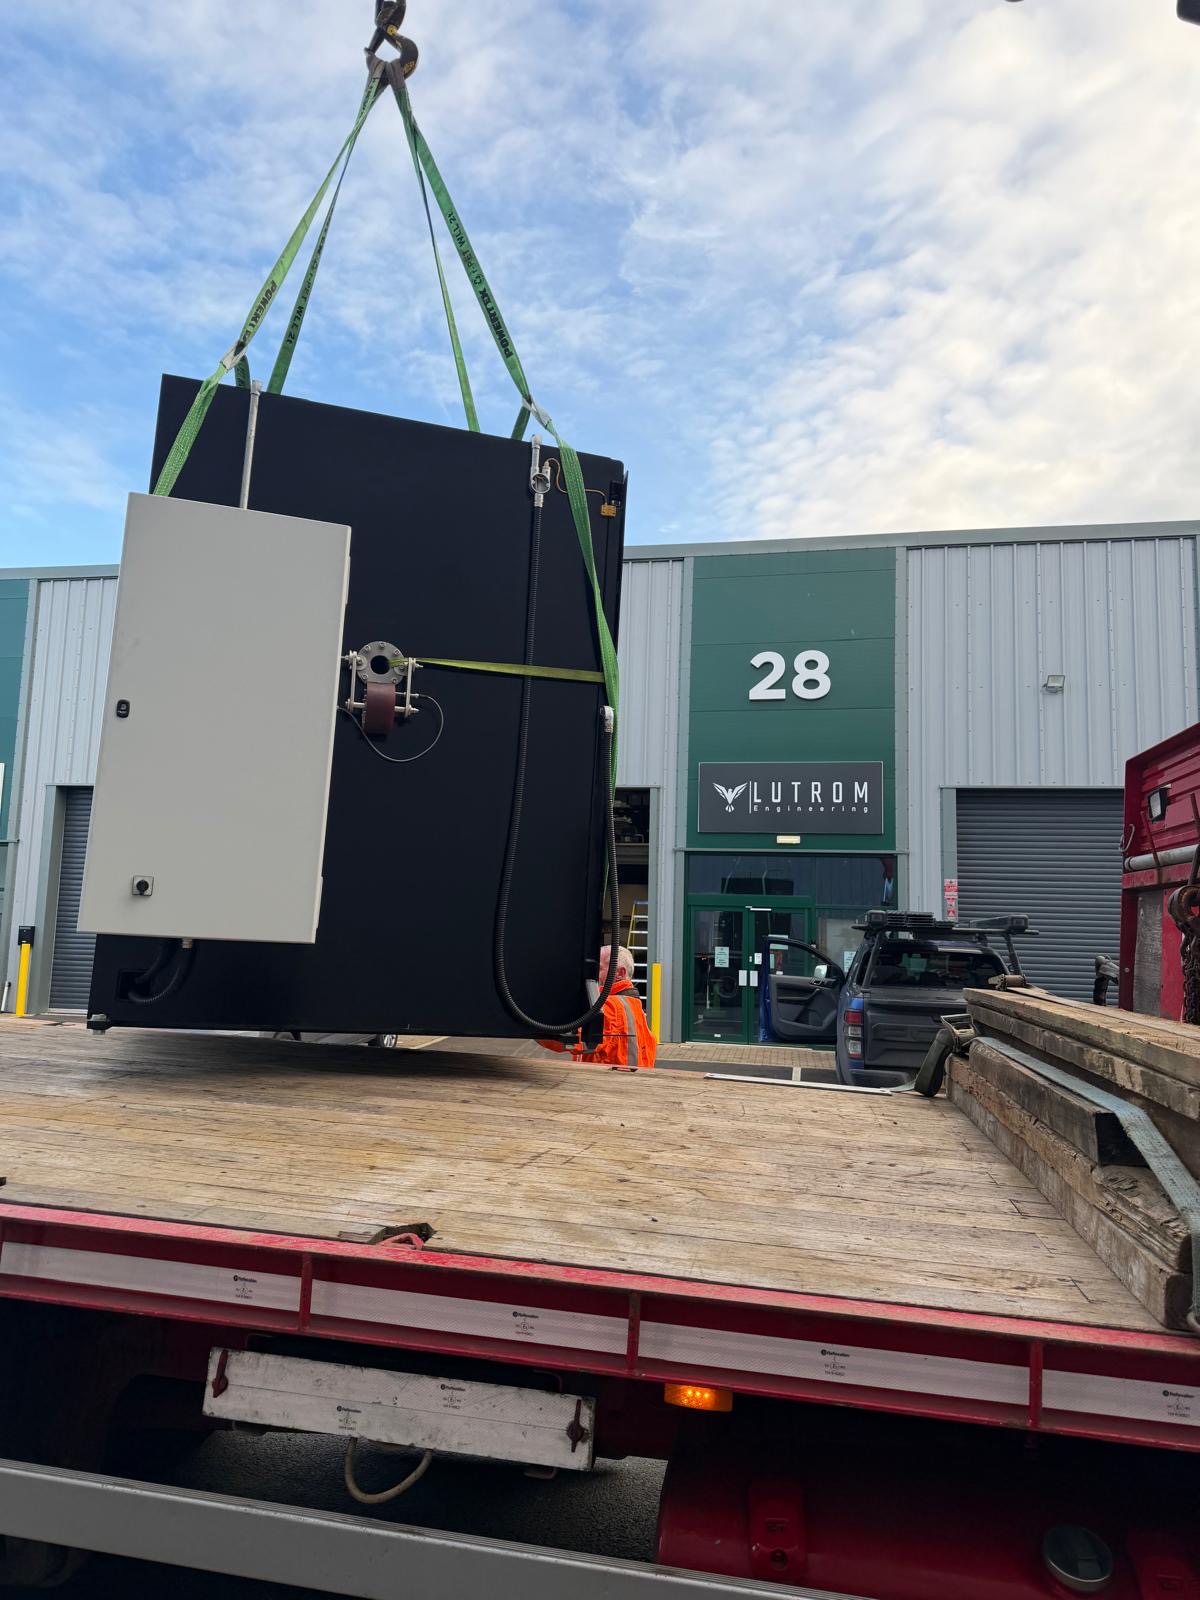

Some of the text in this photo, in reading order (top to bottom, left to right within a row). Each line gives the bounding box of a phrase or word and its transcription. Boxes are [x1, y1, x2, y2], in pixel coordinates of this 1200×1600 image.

[453, 227, 466, 247] WLL
[292, 305, 305, 330] WLL
[478, 287, 514, 359] POWERTEX
[748, 649, 831, 700] 28
[753, 781, 868, 803] LUTROM
[753, 804, 868, 813] Engineering
